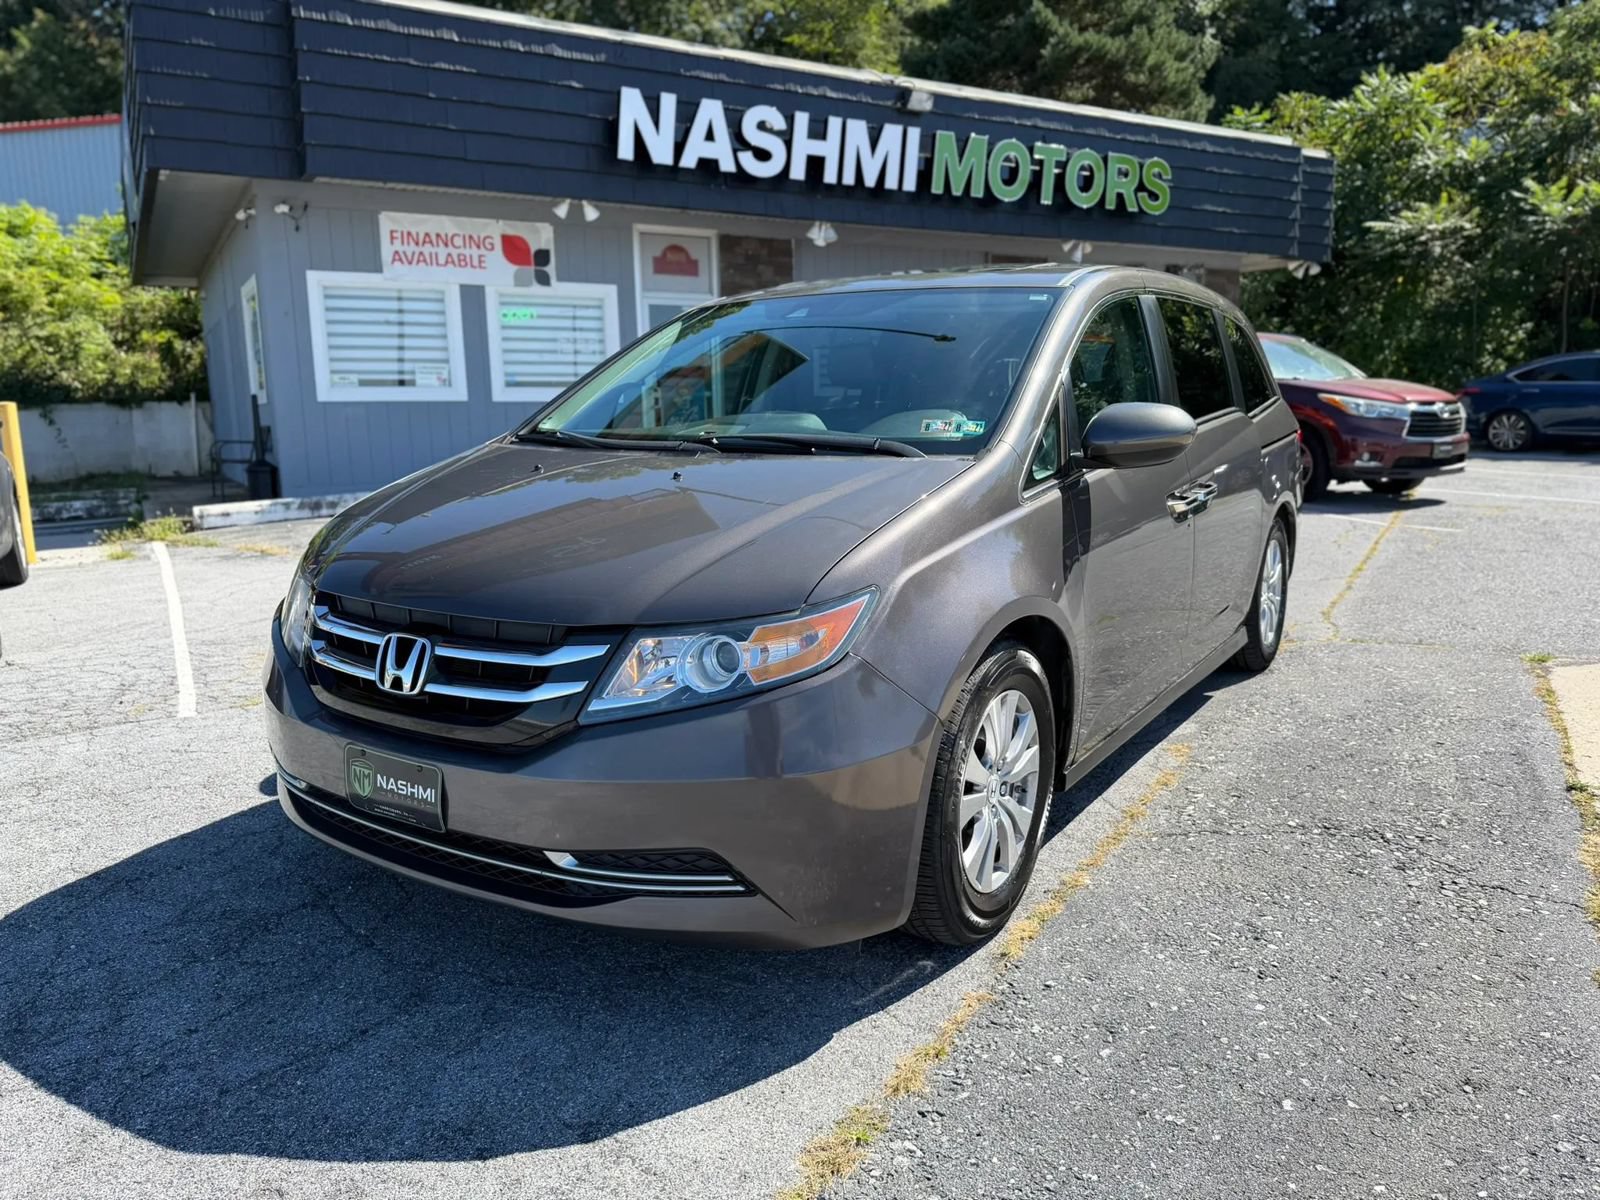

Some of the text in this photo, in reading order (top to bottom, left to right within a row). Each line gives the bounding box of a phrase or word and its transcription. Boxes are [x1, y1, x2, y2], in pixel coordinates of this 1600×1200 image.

[617, 86, 1172, 215] NASHMI MOTORS
[389, 229, 496, 252] FINANCING
[391, 250, 488, 270] AVAILABLE
[376, 773, 435, 803] NASHMI
